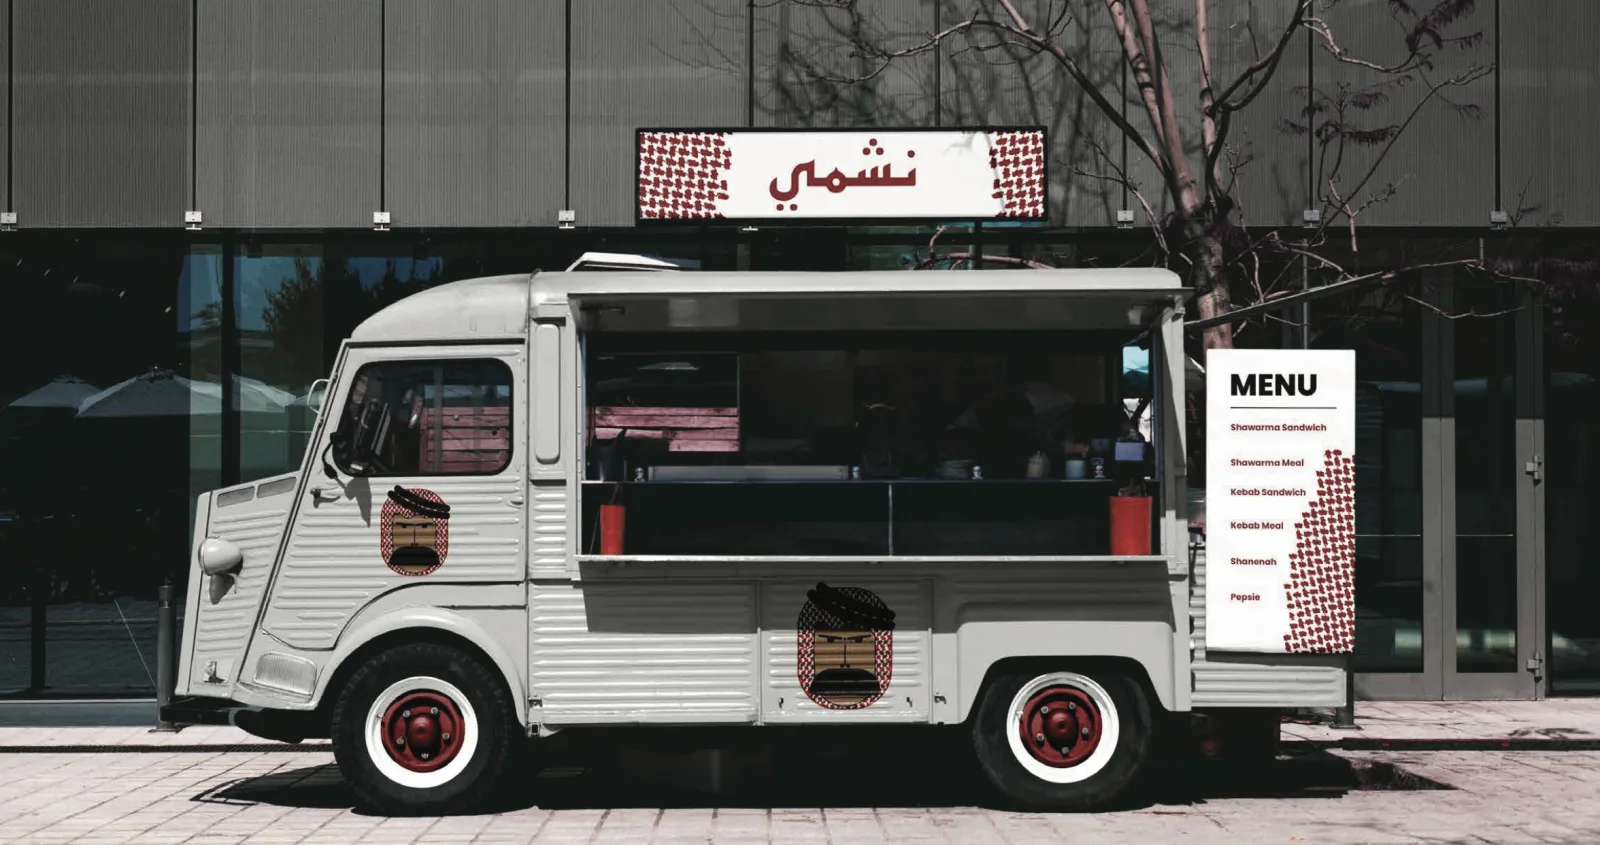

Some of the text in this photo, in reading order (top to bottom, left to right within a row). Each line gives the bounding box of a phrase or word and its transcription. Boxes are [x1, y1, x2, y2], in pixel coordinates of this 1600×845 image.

[769, 137, 917, 211] نشمي
[1230, 373, 1318, 397] MENU
[1230, 423, 1328, 432] Shawarma Sandwich
[1230, 458, 1305, 467] Shawarma Meal
[1230, 488, 1307, 497] Kebab Sandwich
[1230, 521, 1284, 530] Kebab Meal
[1230, 557, 1278, 566] Shanenah
[1230, 592, 1261, 603] Pepsie
